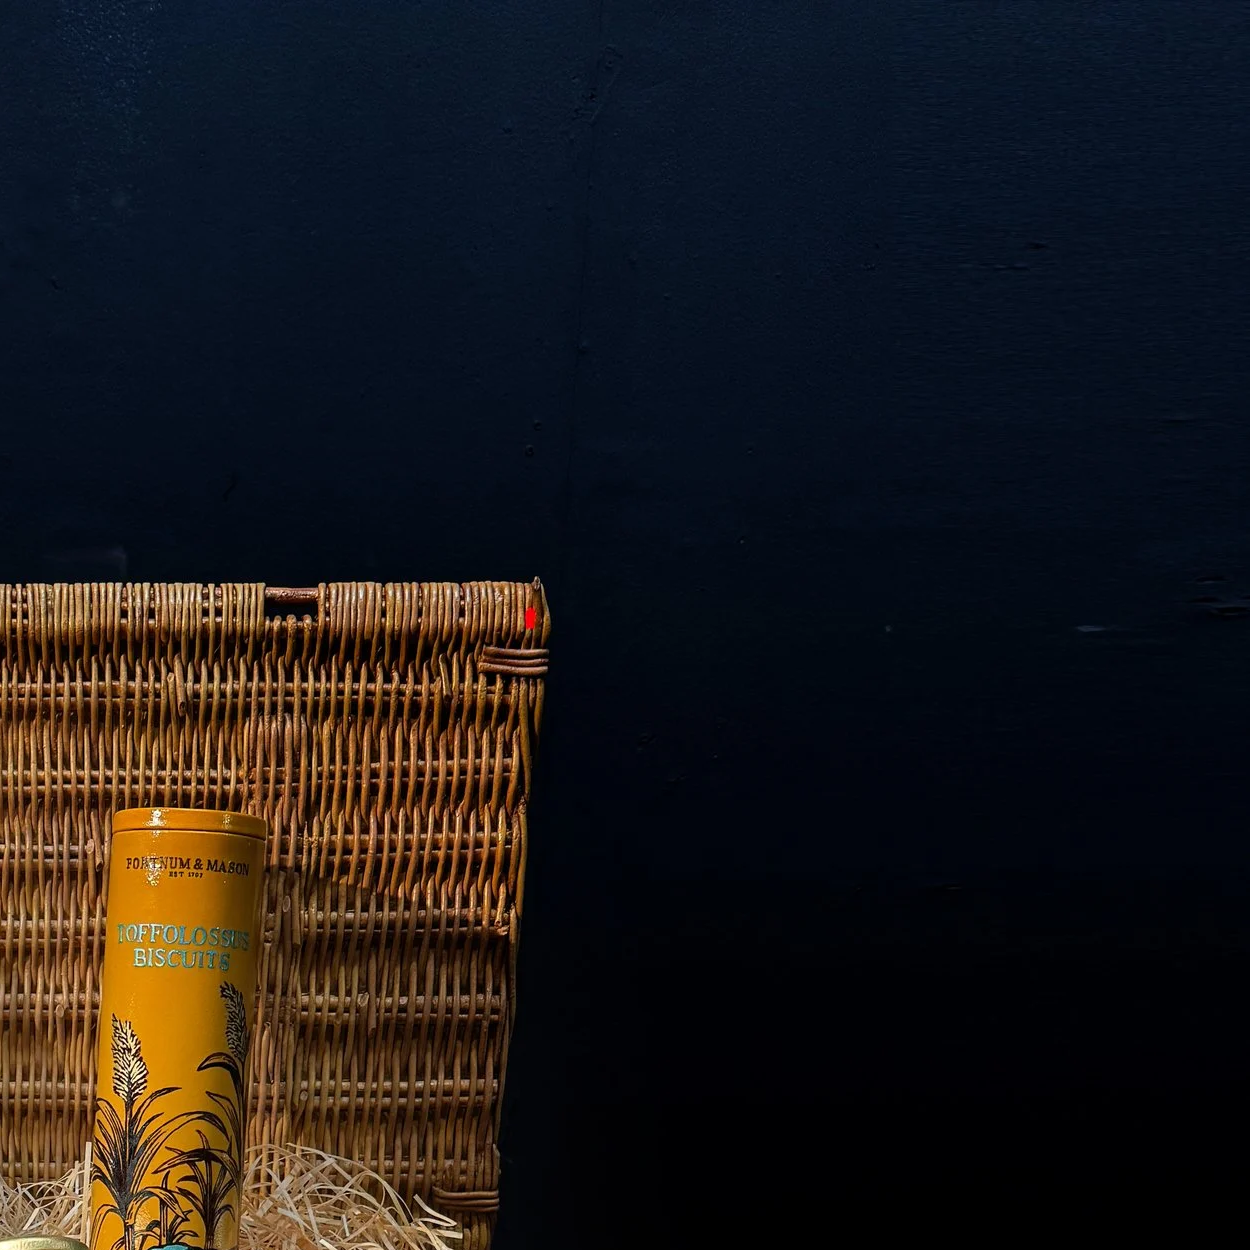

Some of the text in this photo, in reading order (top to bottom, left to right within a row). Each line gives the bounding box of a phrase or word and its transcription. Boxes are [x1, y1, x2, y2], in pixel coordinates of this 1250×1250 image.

[126, 856, 250, 876] FORTNUM & MASON
[133, 948, 230, 971] BISCUITS
